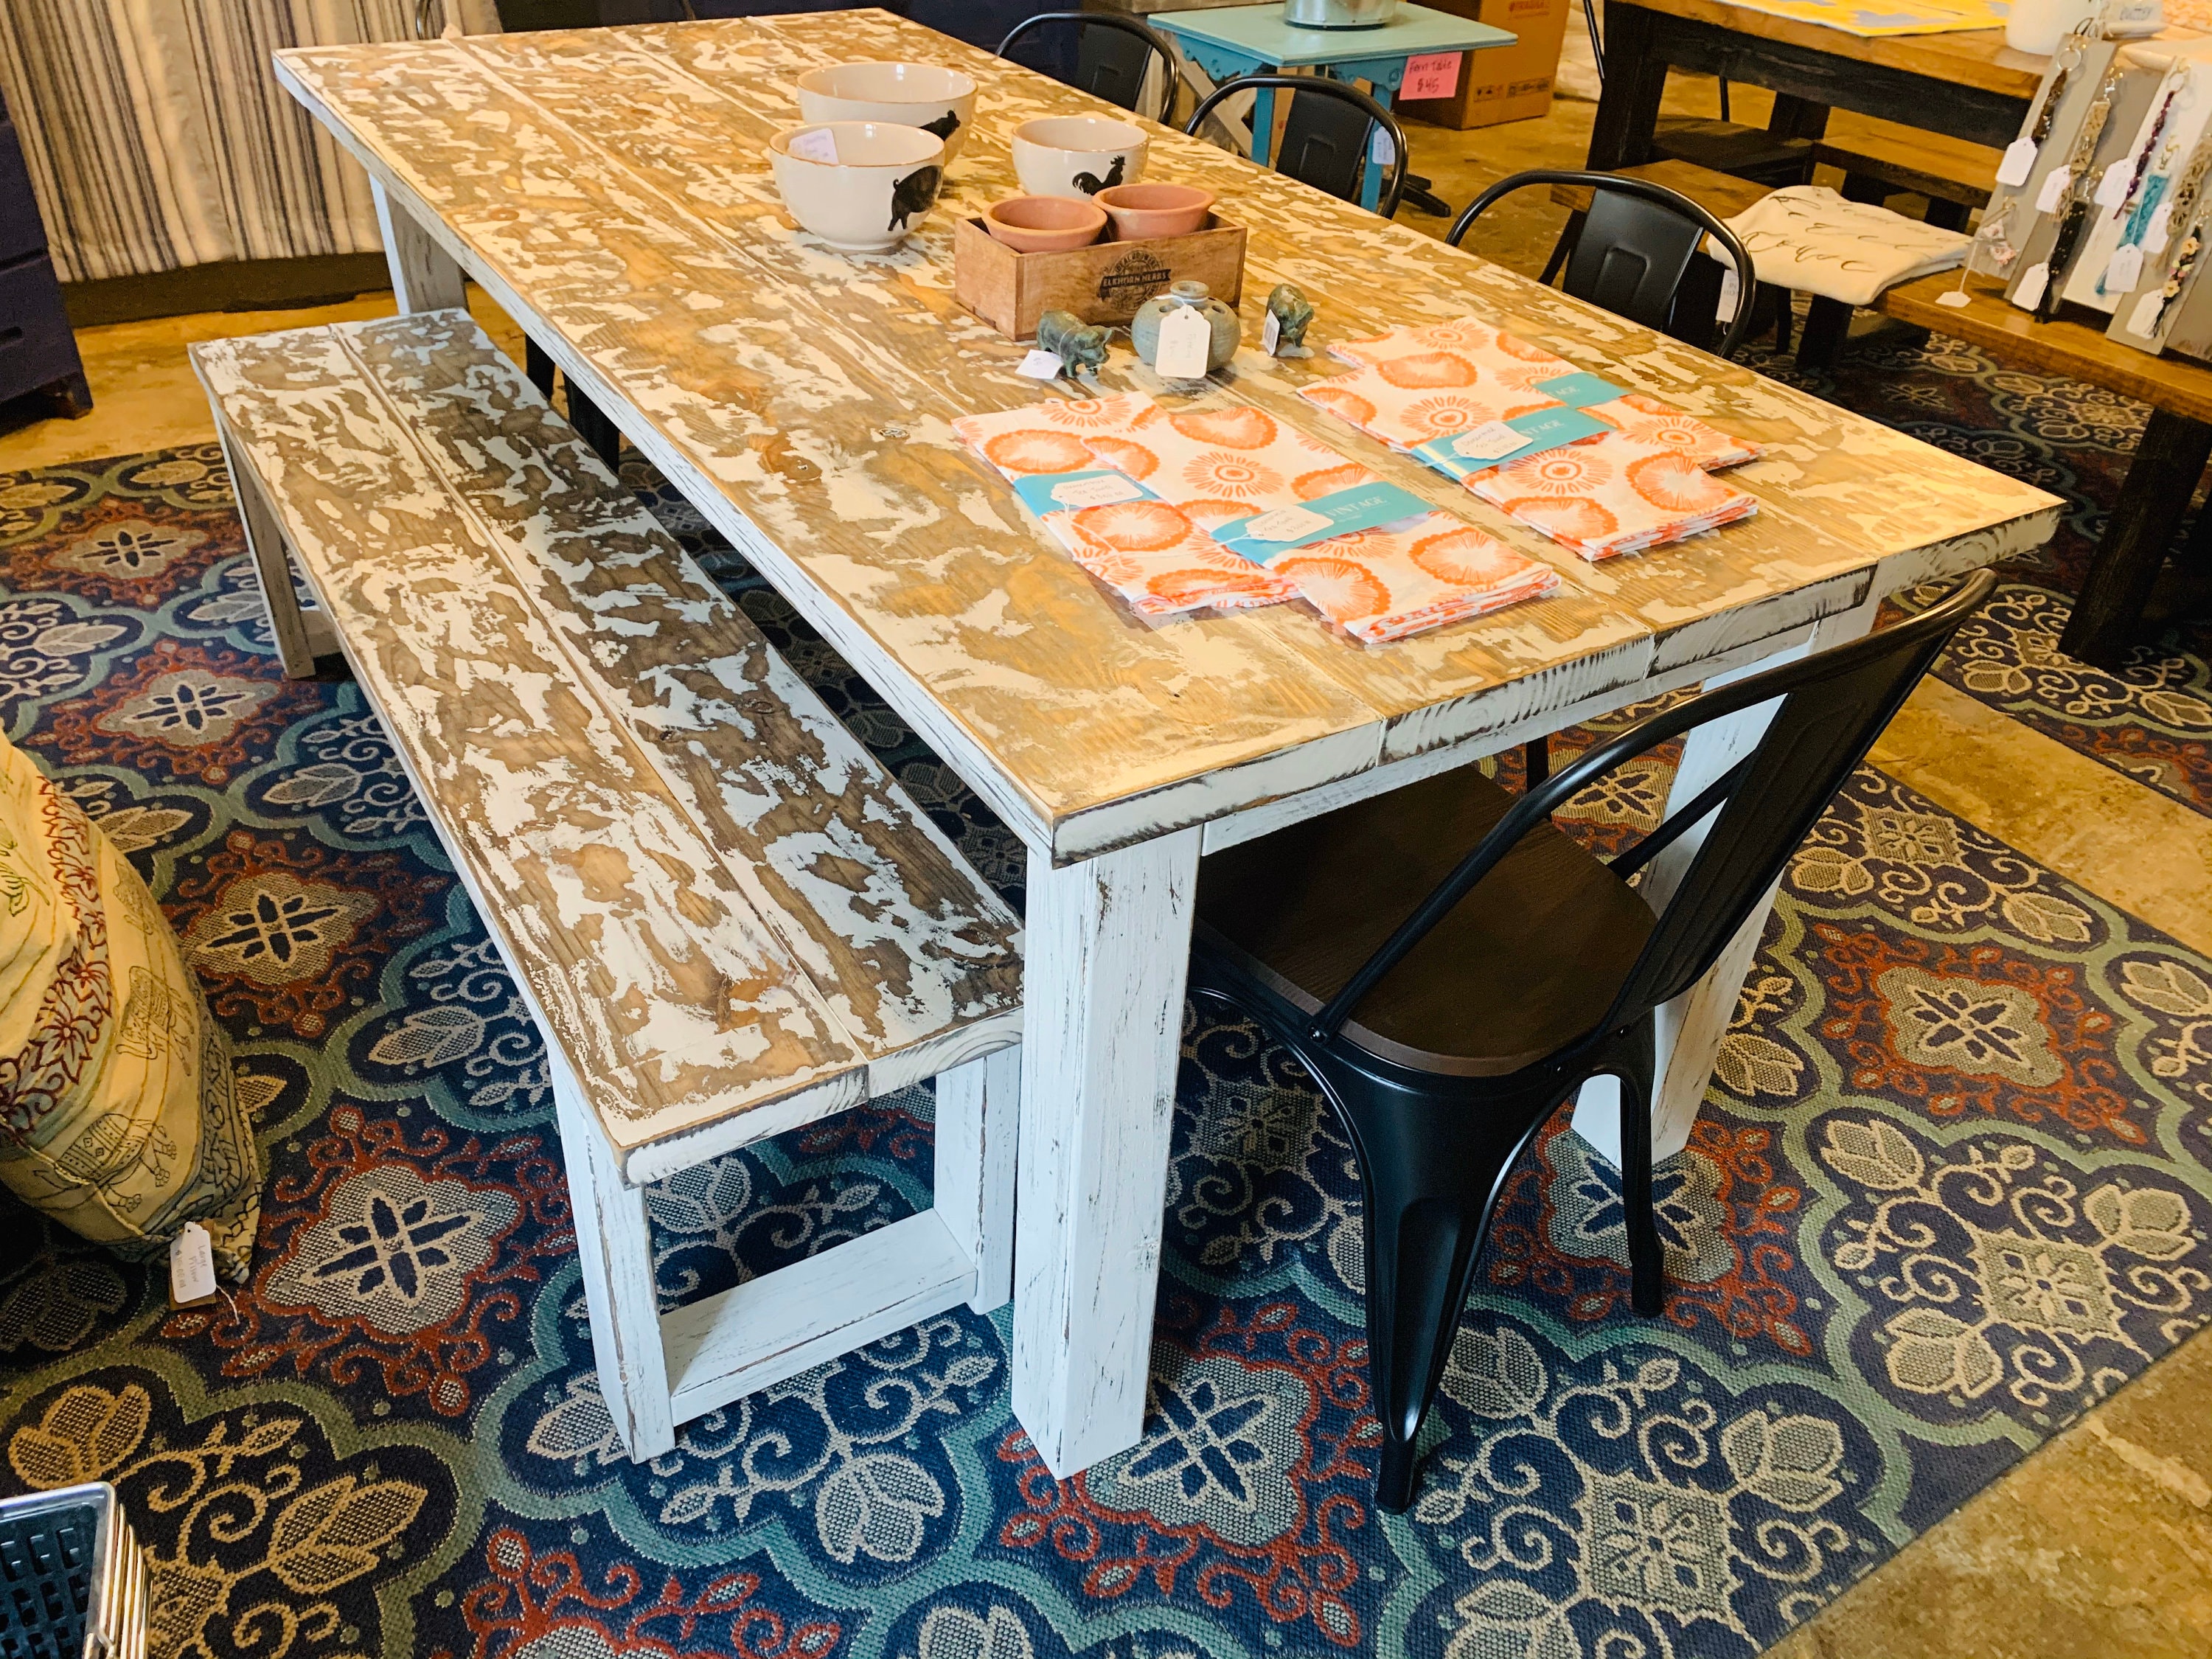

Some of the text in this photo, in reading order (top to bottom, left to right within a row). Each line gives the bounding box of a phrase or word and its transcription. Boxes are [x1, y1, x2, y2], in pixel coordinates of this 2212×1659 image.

[1432, 59, 1452, 72] Table
[1417, 77, 1439, 94] $45
[1103, 275, 1140, 288] ELKHORN
[1324, 495, 1388, 517] VINTAGE
[198, 1245, 207, 1267] Large
